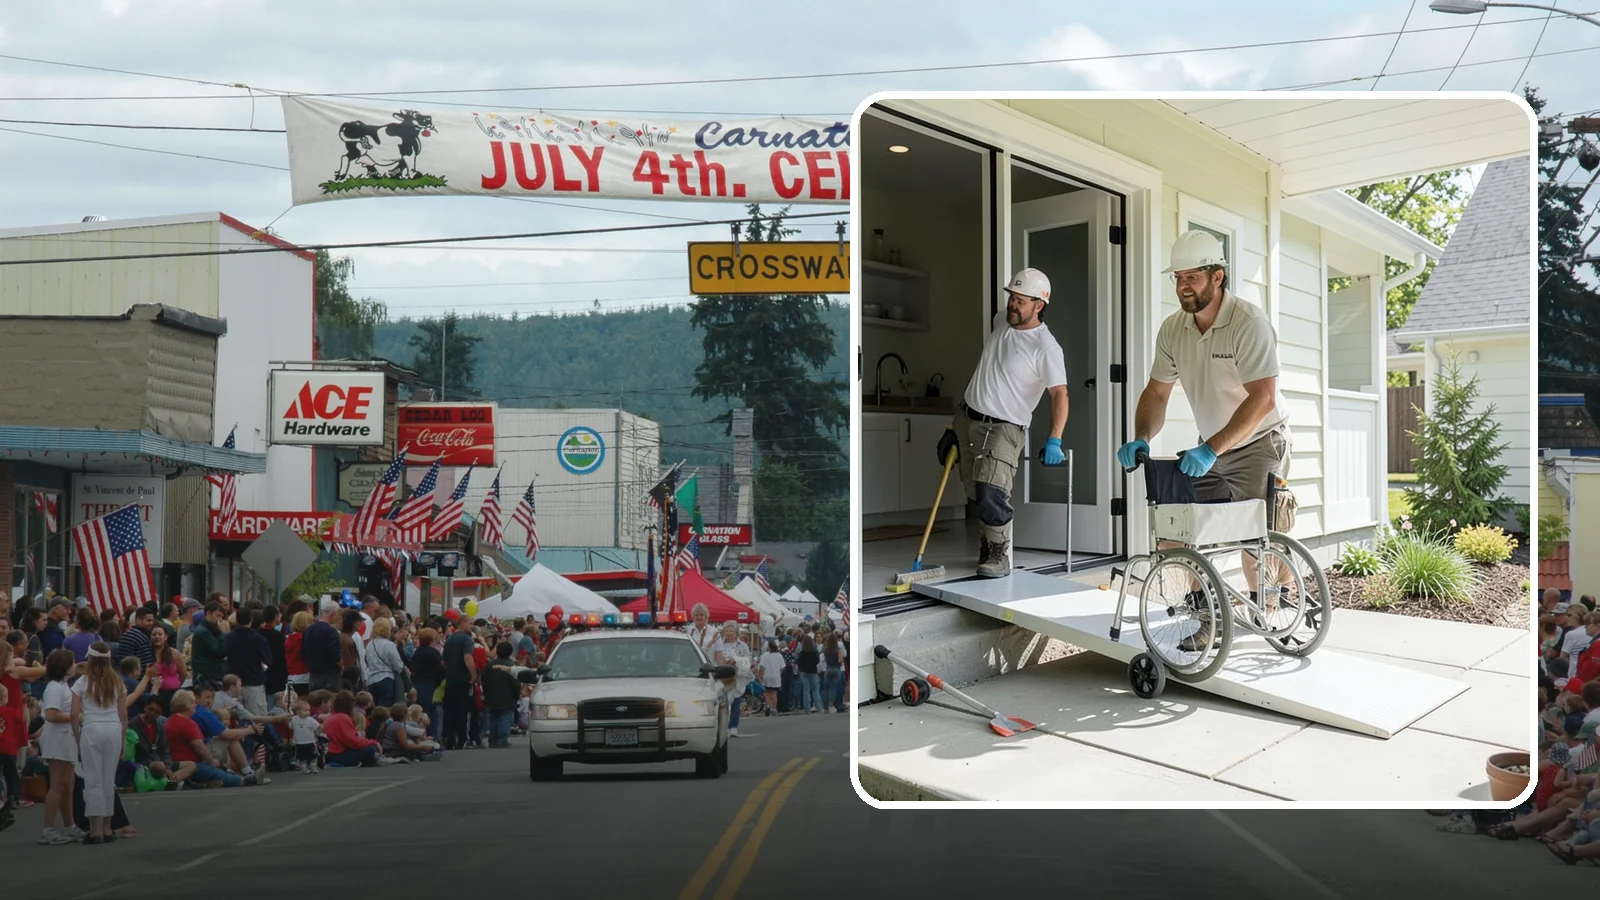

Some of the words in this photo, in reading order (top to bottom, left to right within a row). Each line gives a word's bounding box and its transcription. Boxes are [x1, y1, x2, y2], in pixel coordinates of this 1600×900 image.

[695, 121, 850, 150] Carnat
[481, 141, 605, 192] JULY
[632, 150, 747, 197] 4th.
[697, 254, 850, 280] CROSSWA
[283, 380, 373, 420] ACE
[405, 409, 452, 423] CEDAR
[461, 409, 485, 421] LOG
[283, 421, 370, 436] Hardware
[416, 428, 476, 447] Coca-Cola
[96, 484, 124, 495] Vincent
[126, 486, 135, 495] de
[137, 486, 155, 495] Paul
[699, 535, 730, 543] GLASS
